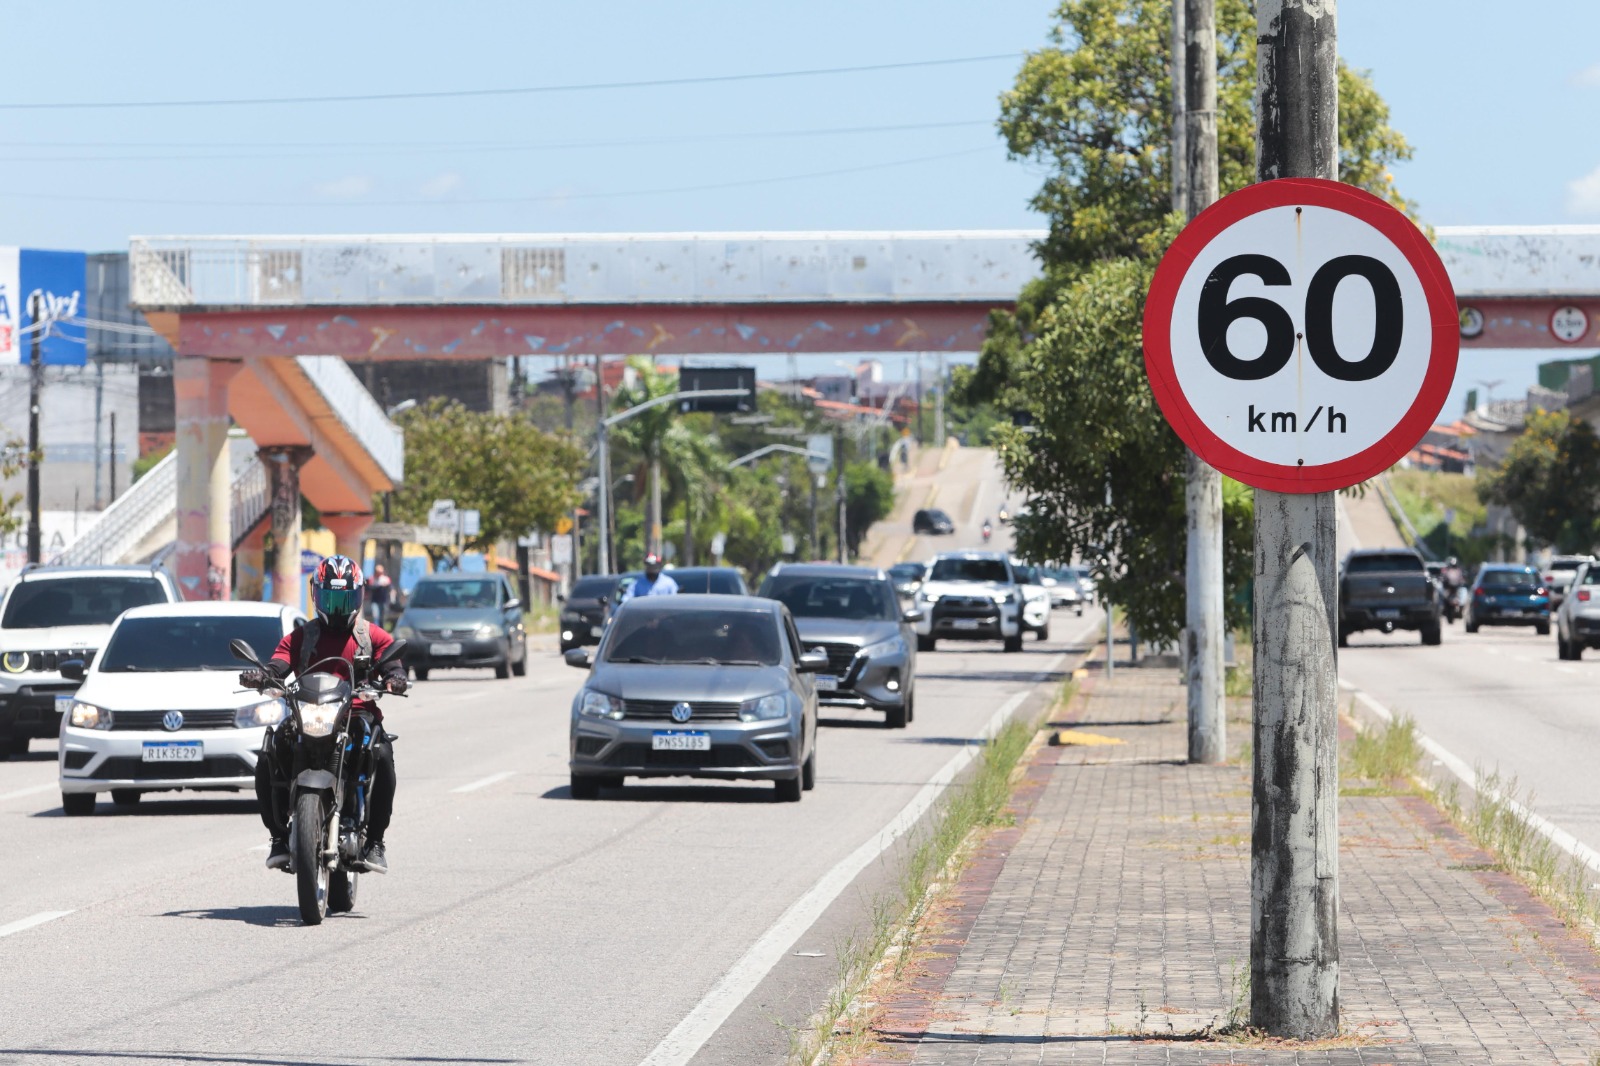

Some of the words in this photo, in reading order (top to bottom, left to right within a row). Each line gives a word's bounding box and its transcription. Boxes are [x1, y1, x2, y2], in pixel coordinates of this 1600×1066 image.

[1197, 253, 1404, 382] 60
[1248, 404, 1347, 433] km/h
[148, 748, 197, 759] RIK3E29
